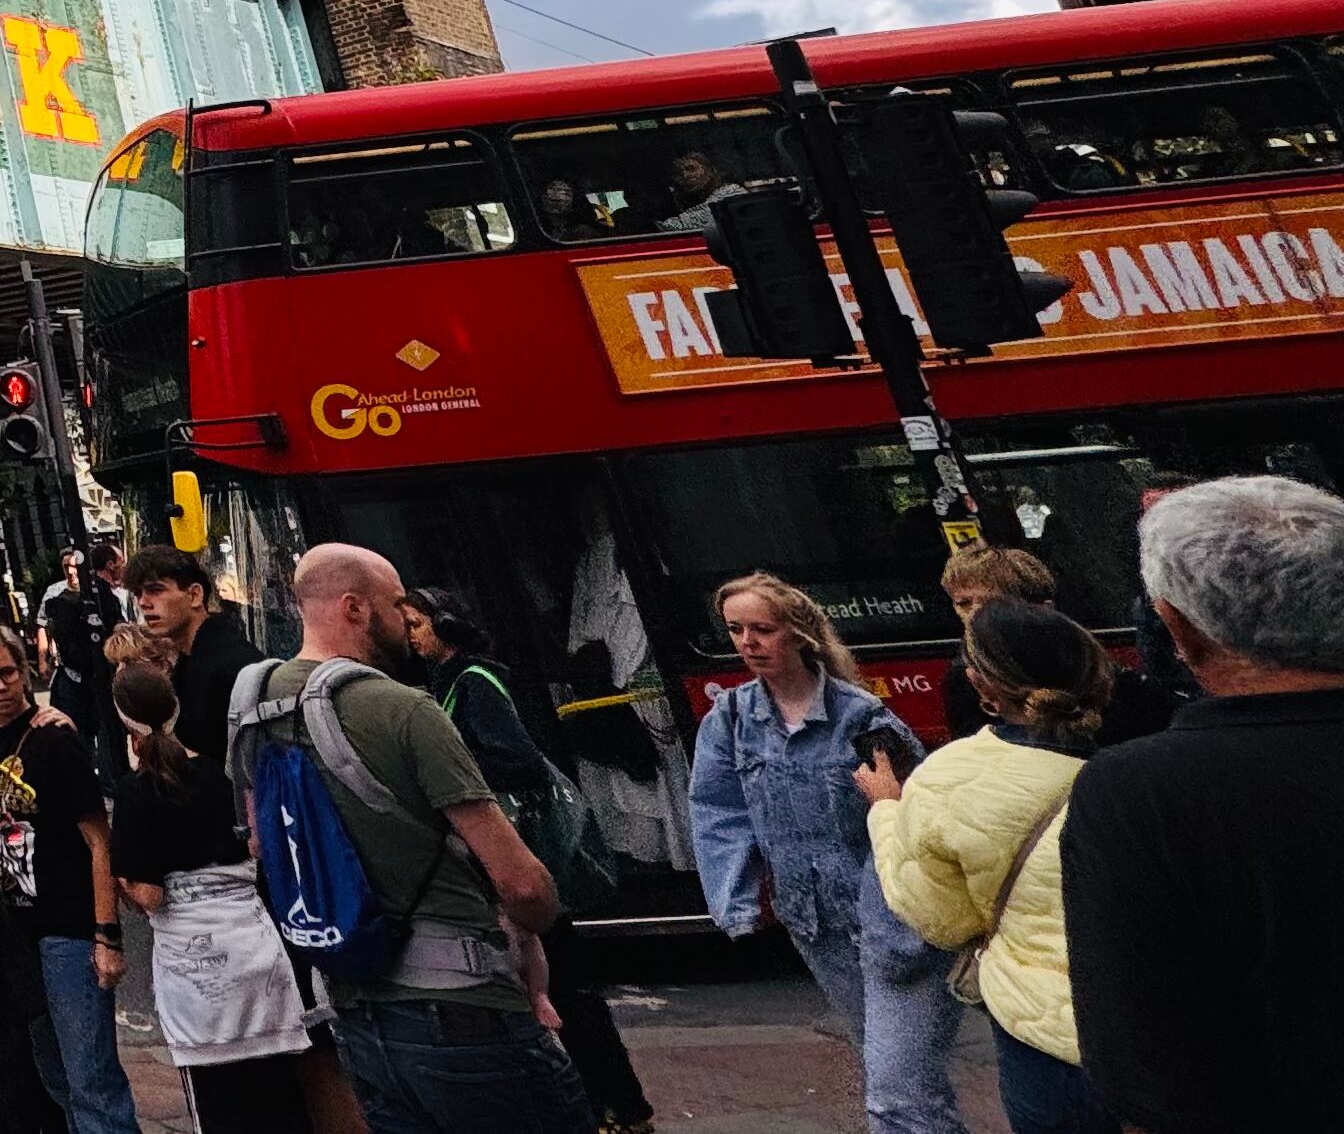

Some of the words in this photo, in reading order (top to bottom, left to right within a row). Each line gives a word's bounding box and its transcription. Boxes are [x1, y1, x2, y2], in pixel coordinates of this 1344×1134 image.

[310, 383, 402, 441] Go
[413, 385, 477, 402] London
[401, 402, 439, 414] LONDON
[440, 398, 481, 411] GENERAL
[864, 593, 925, 616] Heath
[891, 674, 933, 694] MG
